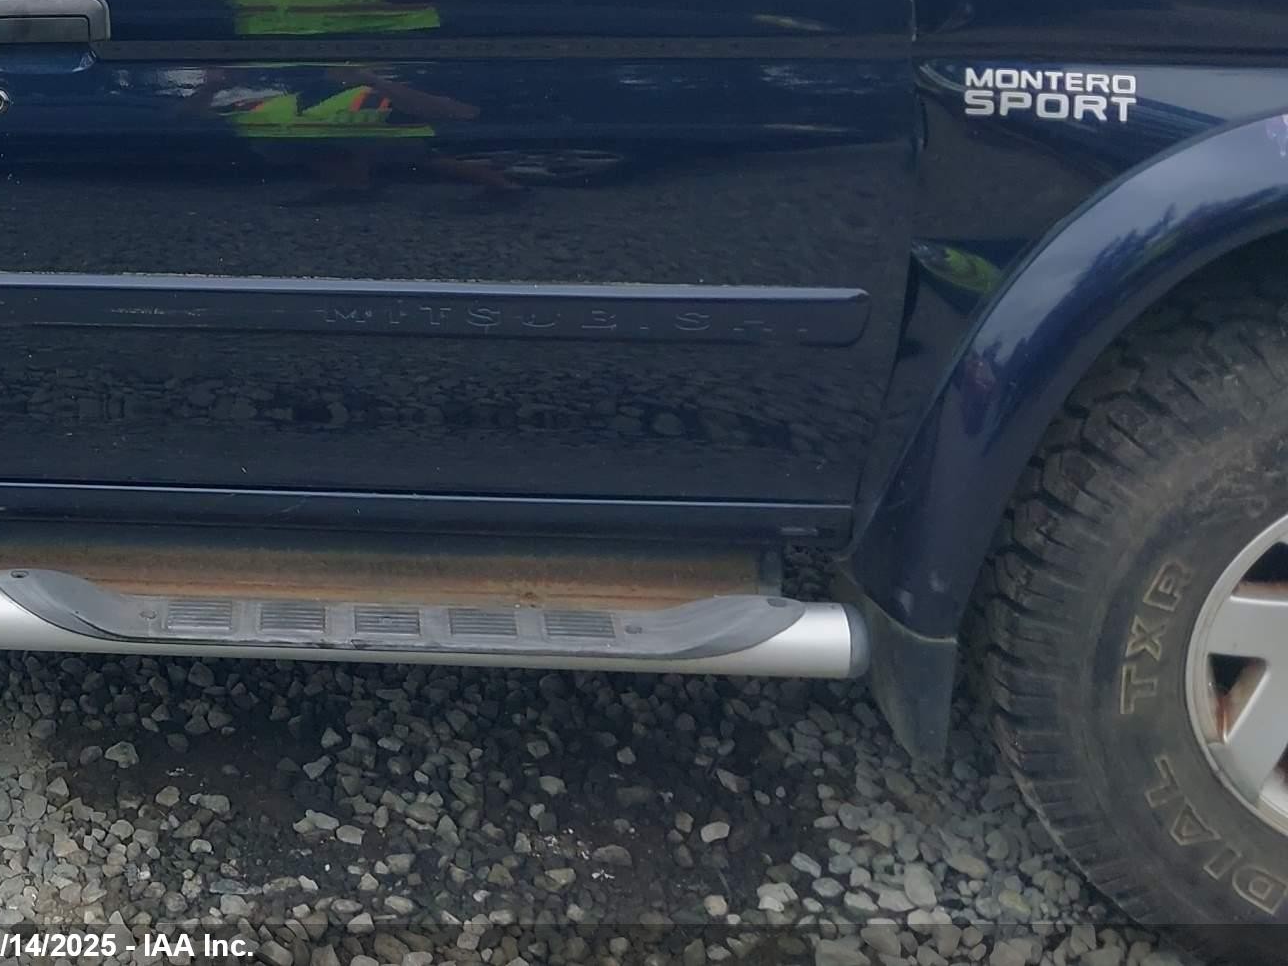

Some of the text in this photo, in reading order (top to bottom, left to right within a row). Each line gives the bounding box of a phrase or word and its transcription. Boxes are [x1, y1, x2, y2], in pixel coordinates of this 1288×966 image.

[964, 67, 1137, 95] MONTERO
[964, 89, 1137, 123] SPORT
[1120, 558, 1194, 715] TXR
